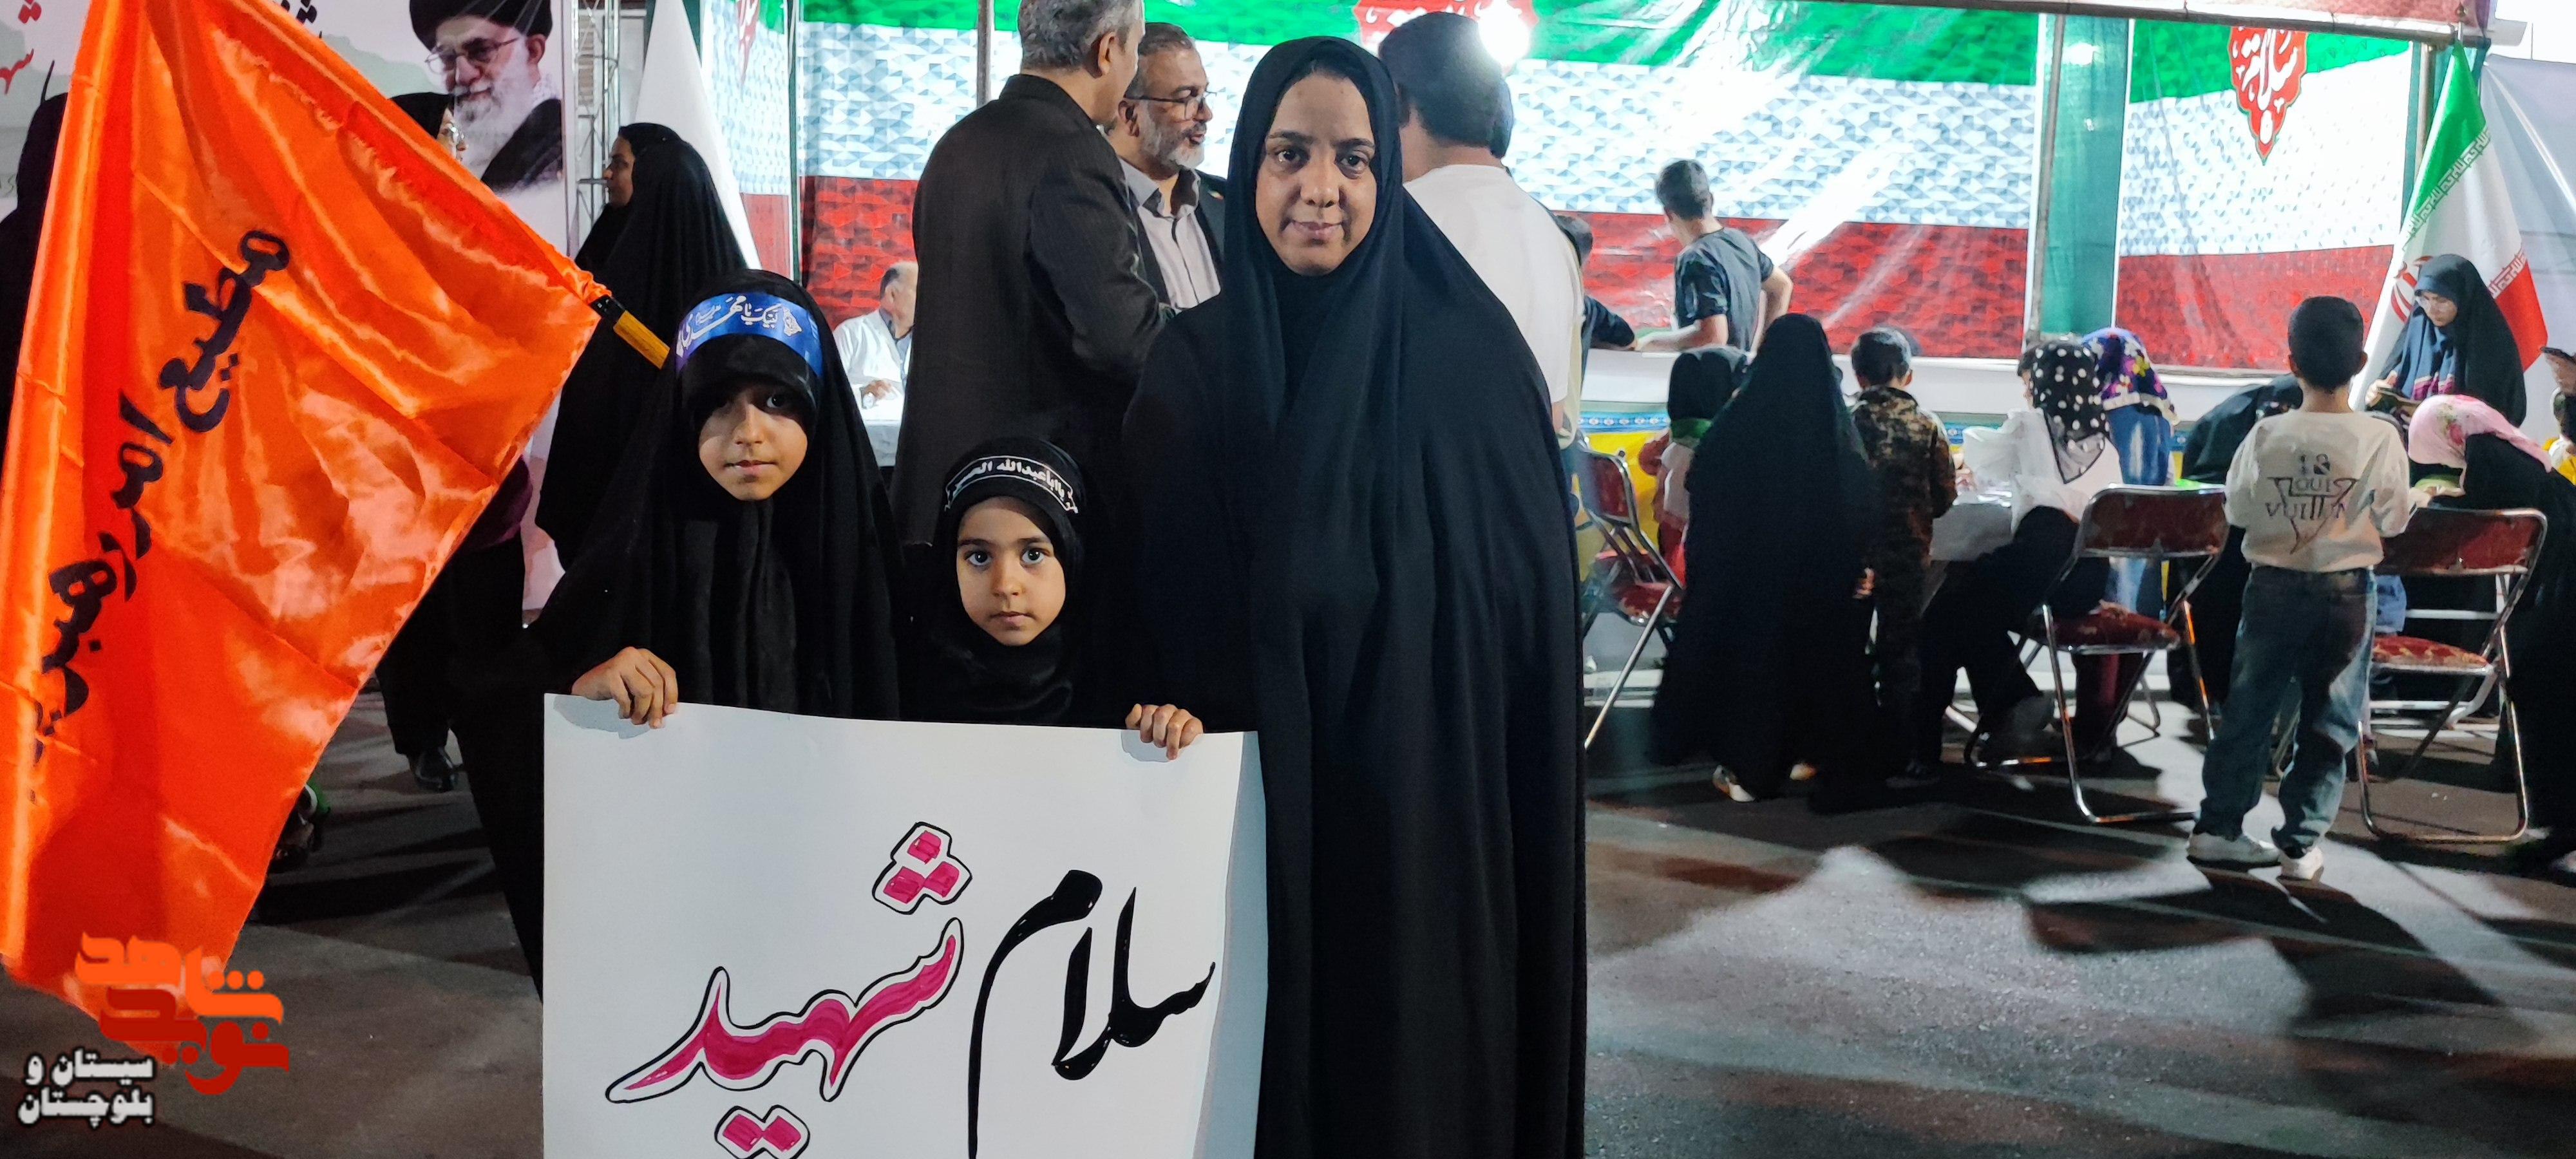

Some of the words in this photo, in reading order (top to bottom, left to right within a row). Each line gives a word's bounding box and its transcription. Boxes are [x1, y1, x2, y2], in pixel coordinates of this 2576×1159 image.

[158, 230, 290, 433] مطیع
[605, 822, 973, 1159] شهید
[968, 869, 1216, 1159] سلام
